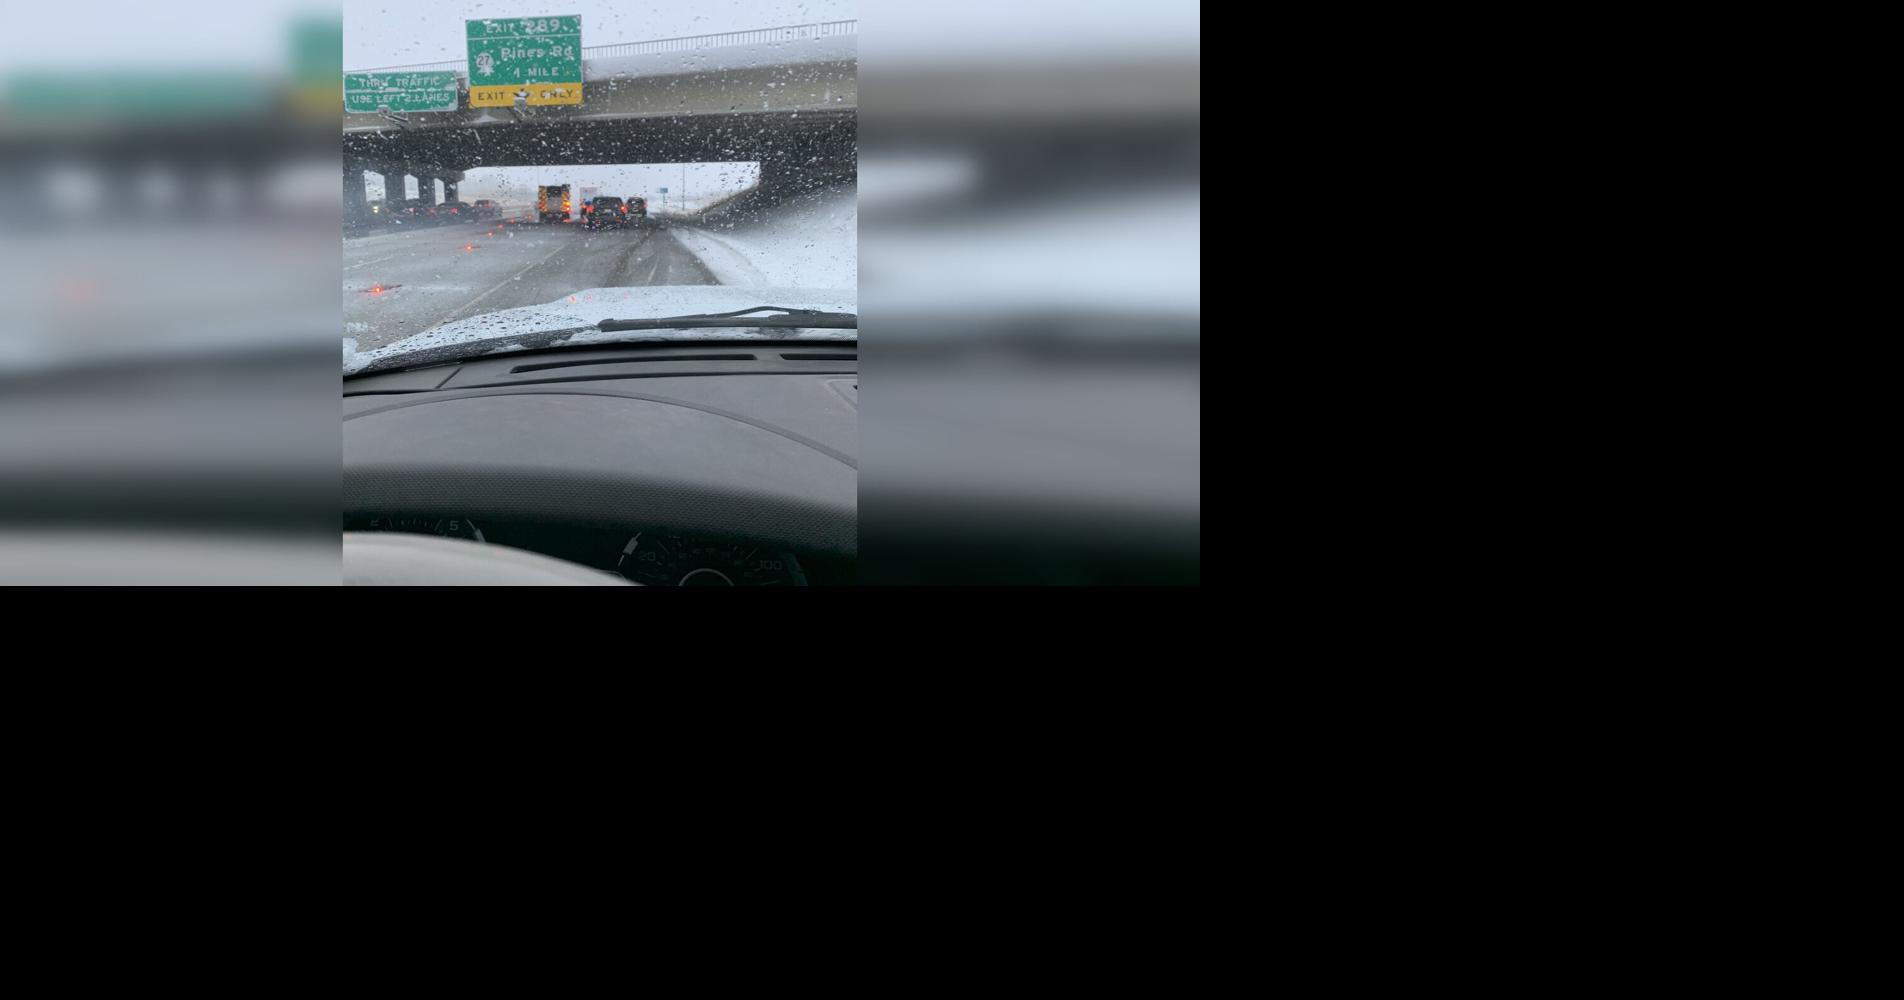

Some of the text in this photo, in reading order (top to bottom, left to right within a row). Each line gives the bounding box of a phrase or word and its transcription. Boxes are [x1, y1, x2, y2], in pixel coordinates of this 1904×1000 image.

[486, 19, 560, 33] EXIT 289
[501, 45, 573, 59] Pines Rd
[478, 56, 490, 66] 27
[514, 67, 559, 77] 1 MILE
[359, 77, 440, 88] THRU TRAFFIC
[352, 95, 373, 103] USE
[377, 94, 400, 103] LEFT
[416, 93, 449, 102] LANES
[478, 89, 573, 101] EXIT ONLY
[449, 520, 460, 531] 5
[759, 560, 783, 570] 100
